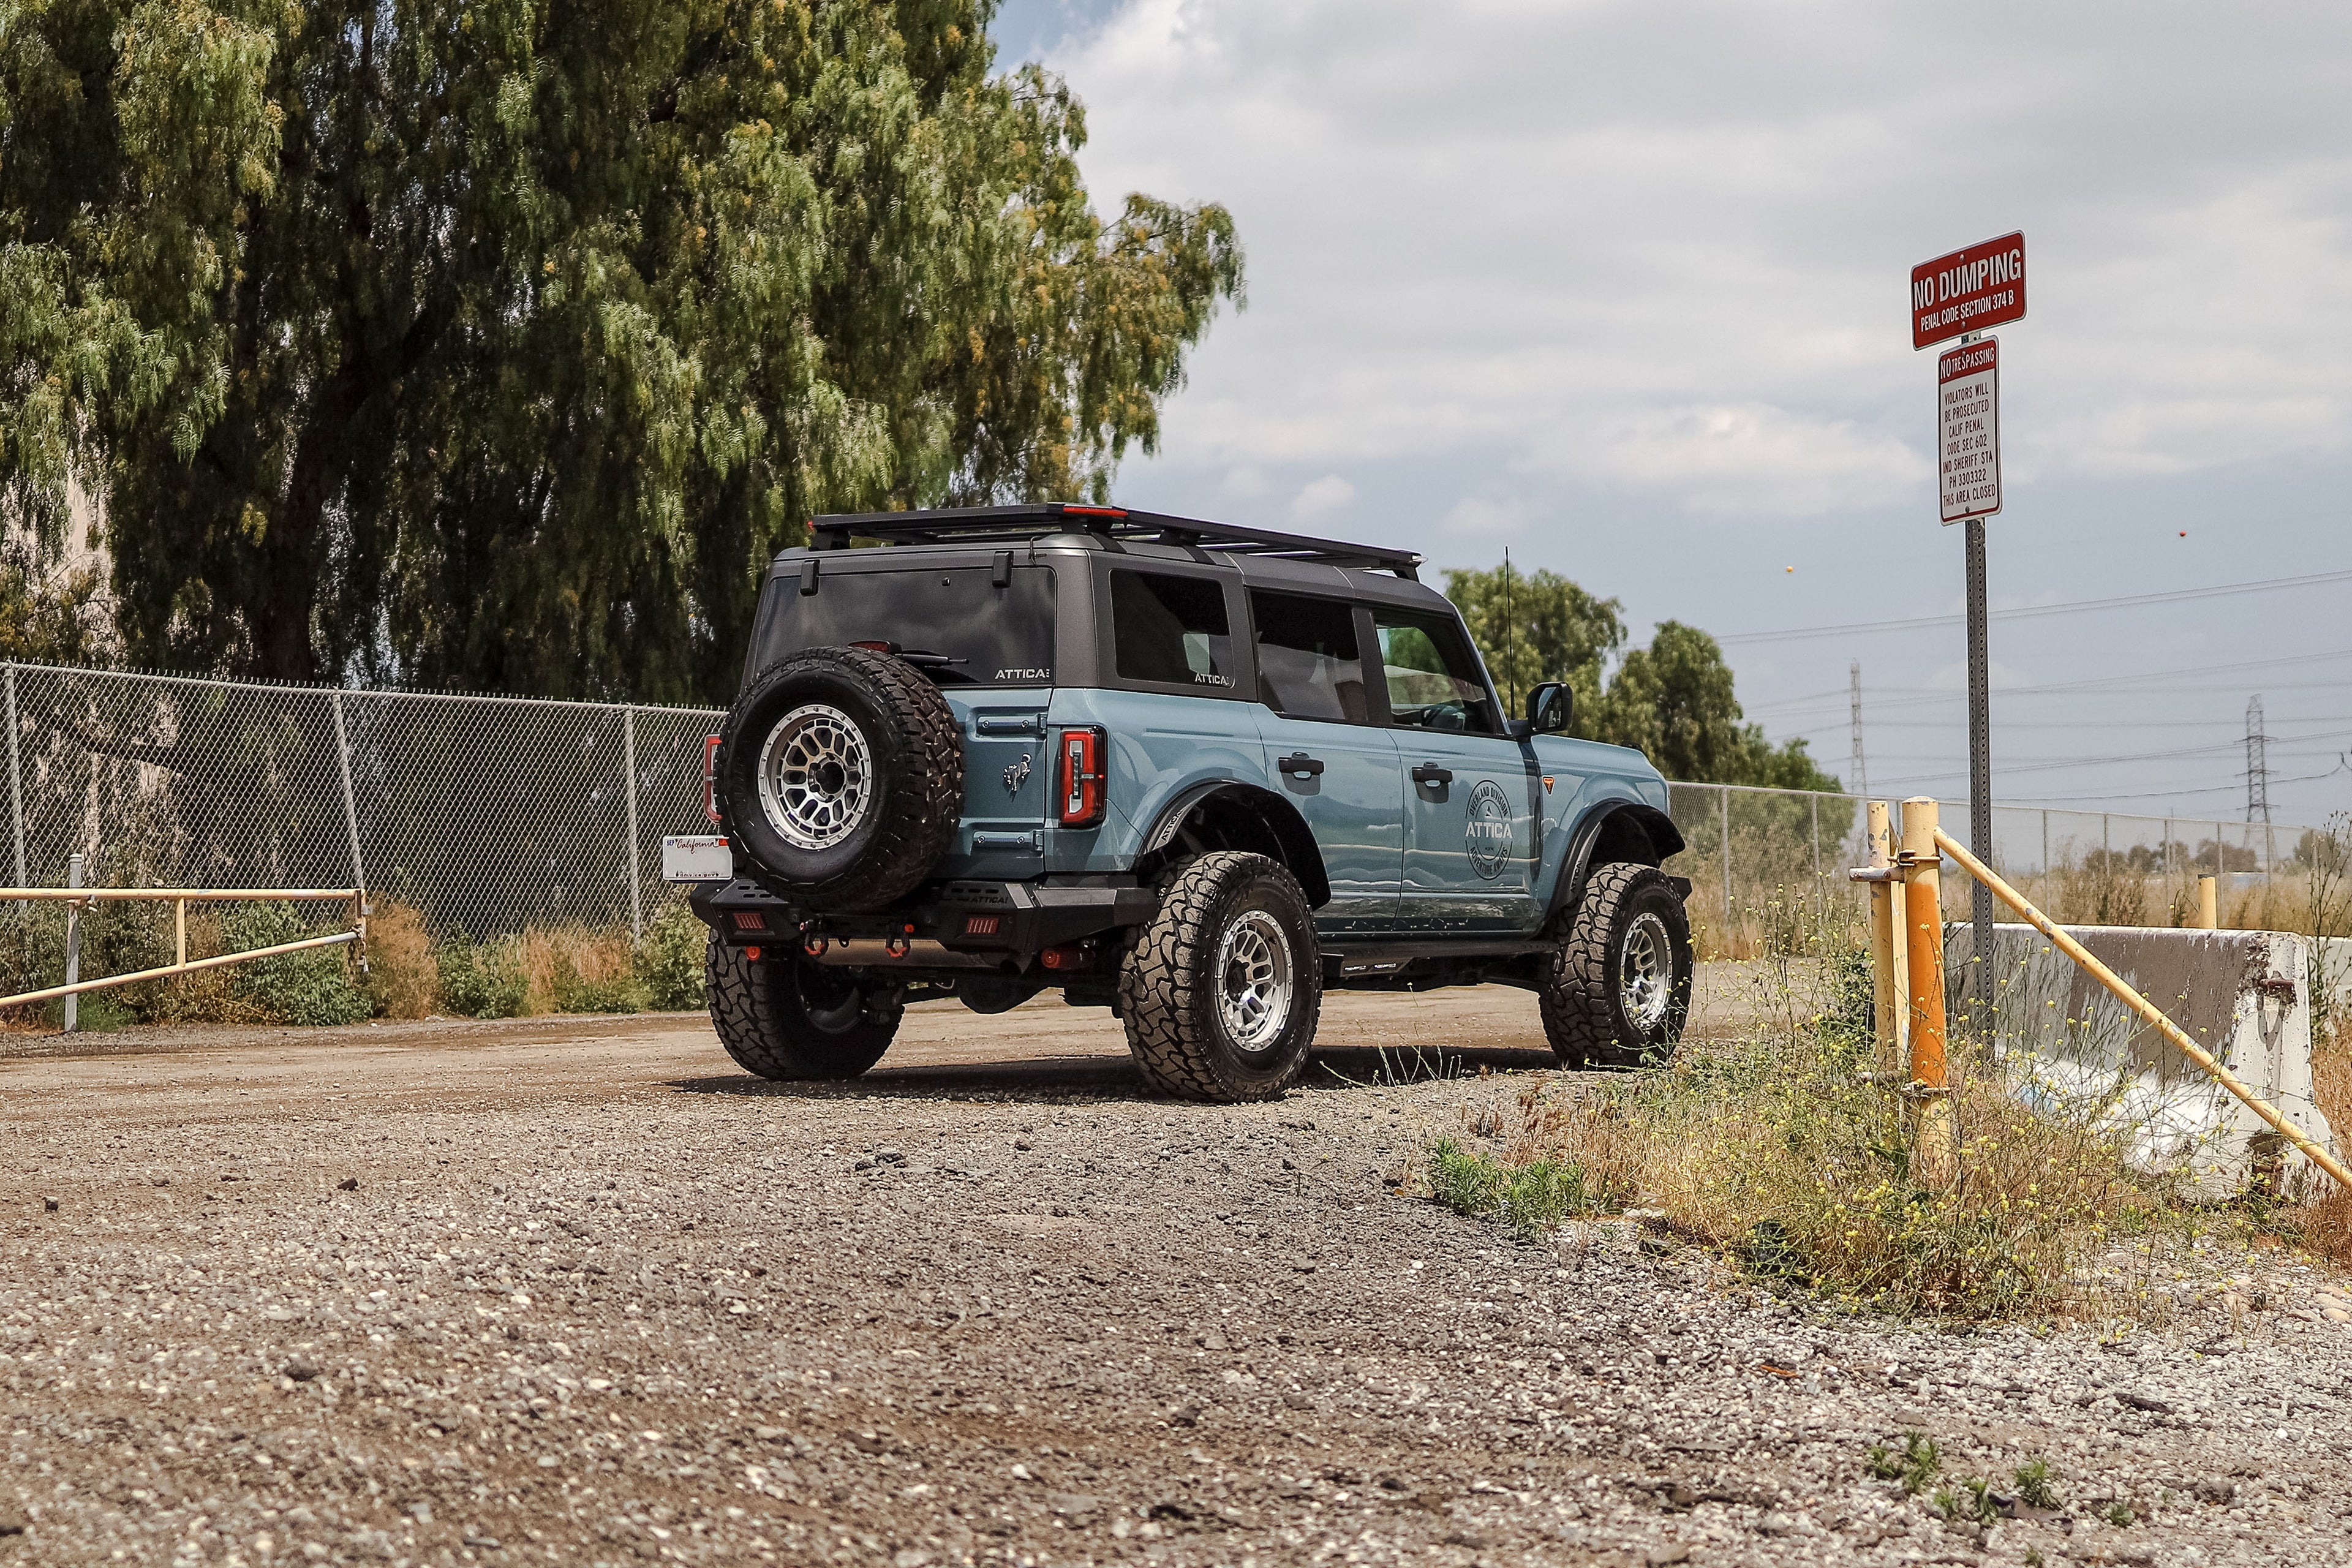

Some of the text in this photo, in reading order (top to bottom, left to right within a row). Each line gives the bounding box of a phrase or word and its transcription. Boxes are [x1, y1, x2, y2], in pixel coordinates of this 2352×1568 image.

[1913, 249, 2021, 311] NO DUMPING
[1921, 289, 2015, 332] PENAL CODE SECTION 374 B
[1940, 347, 1994, 379] NO TRESPASSING
[1945, 382, 1989, 405] VIOLATORS WILL
[1945, 399, 1989, 423] BE PROSECUTED
[1949, 418, 1984, 438] CALIF PENAL
[1947, 434, 1987, 456] CODE SEC 602
[1943, 450, 1993, 474] IND SHERIFF STA
[1949, 468, 1987, 489] PH 3303322
[1943, 484, 1996, 507] THIS AREA CLOSED
[995, 668, 1046, 679] ATTICA
[1194, 672, 1228, 685] ATTICA
[1469, 786, 1509, 817] OVERLAND DIVISION
[1465, 821, 1513, 839] ATTICA
[676, 838, 719, 854] California
